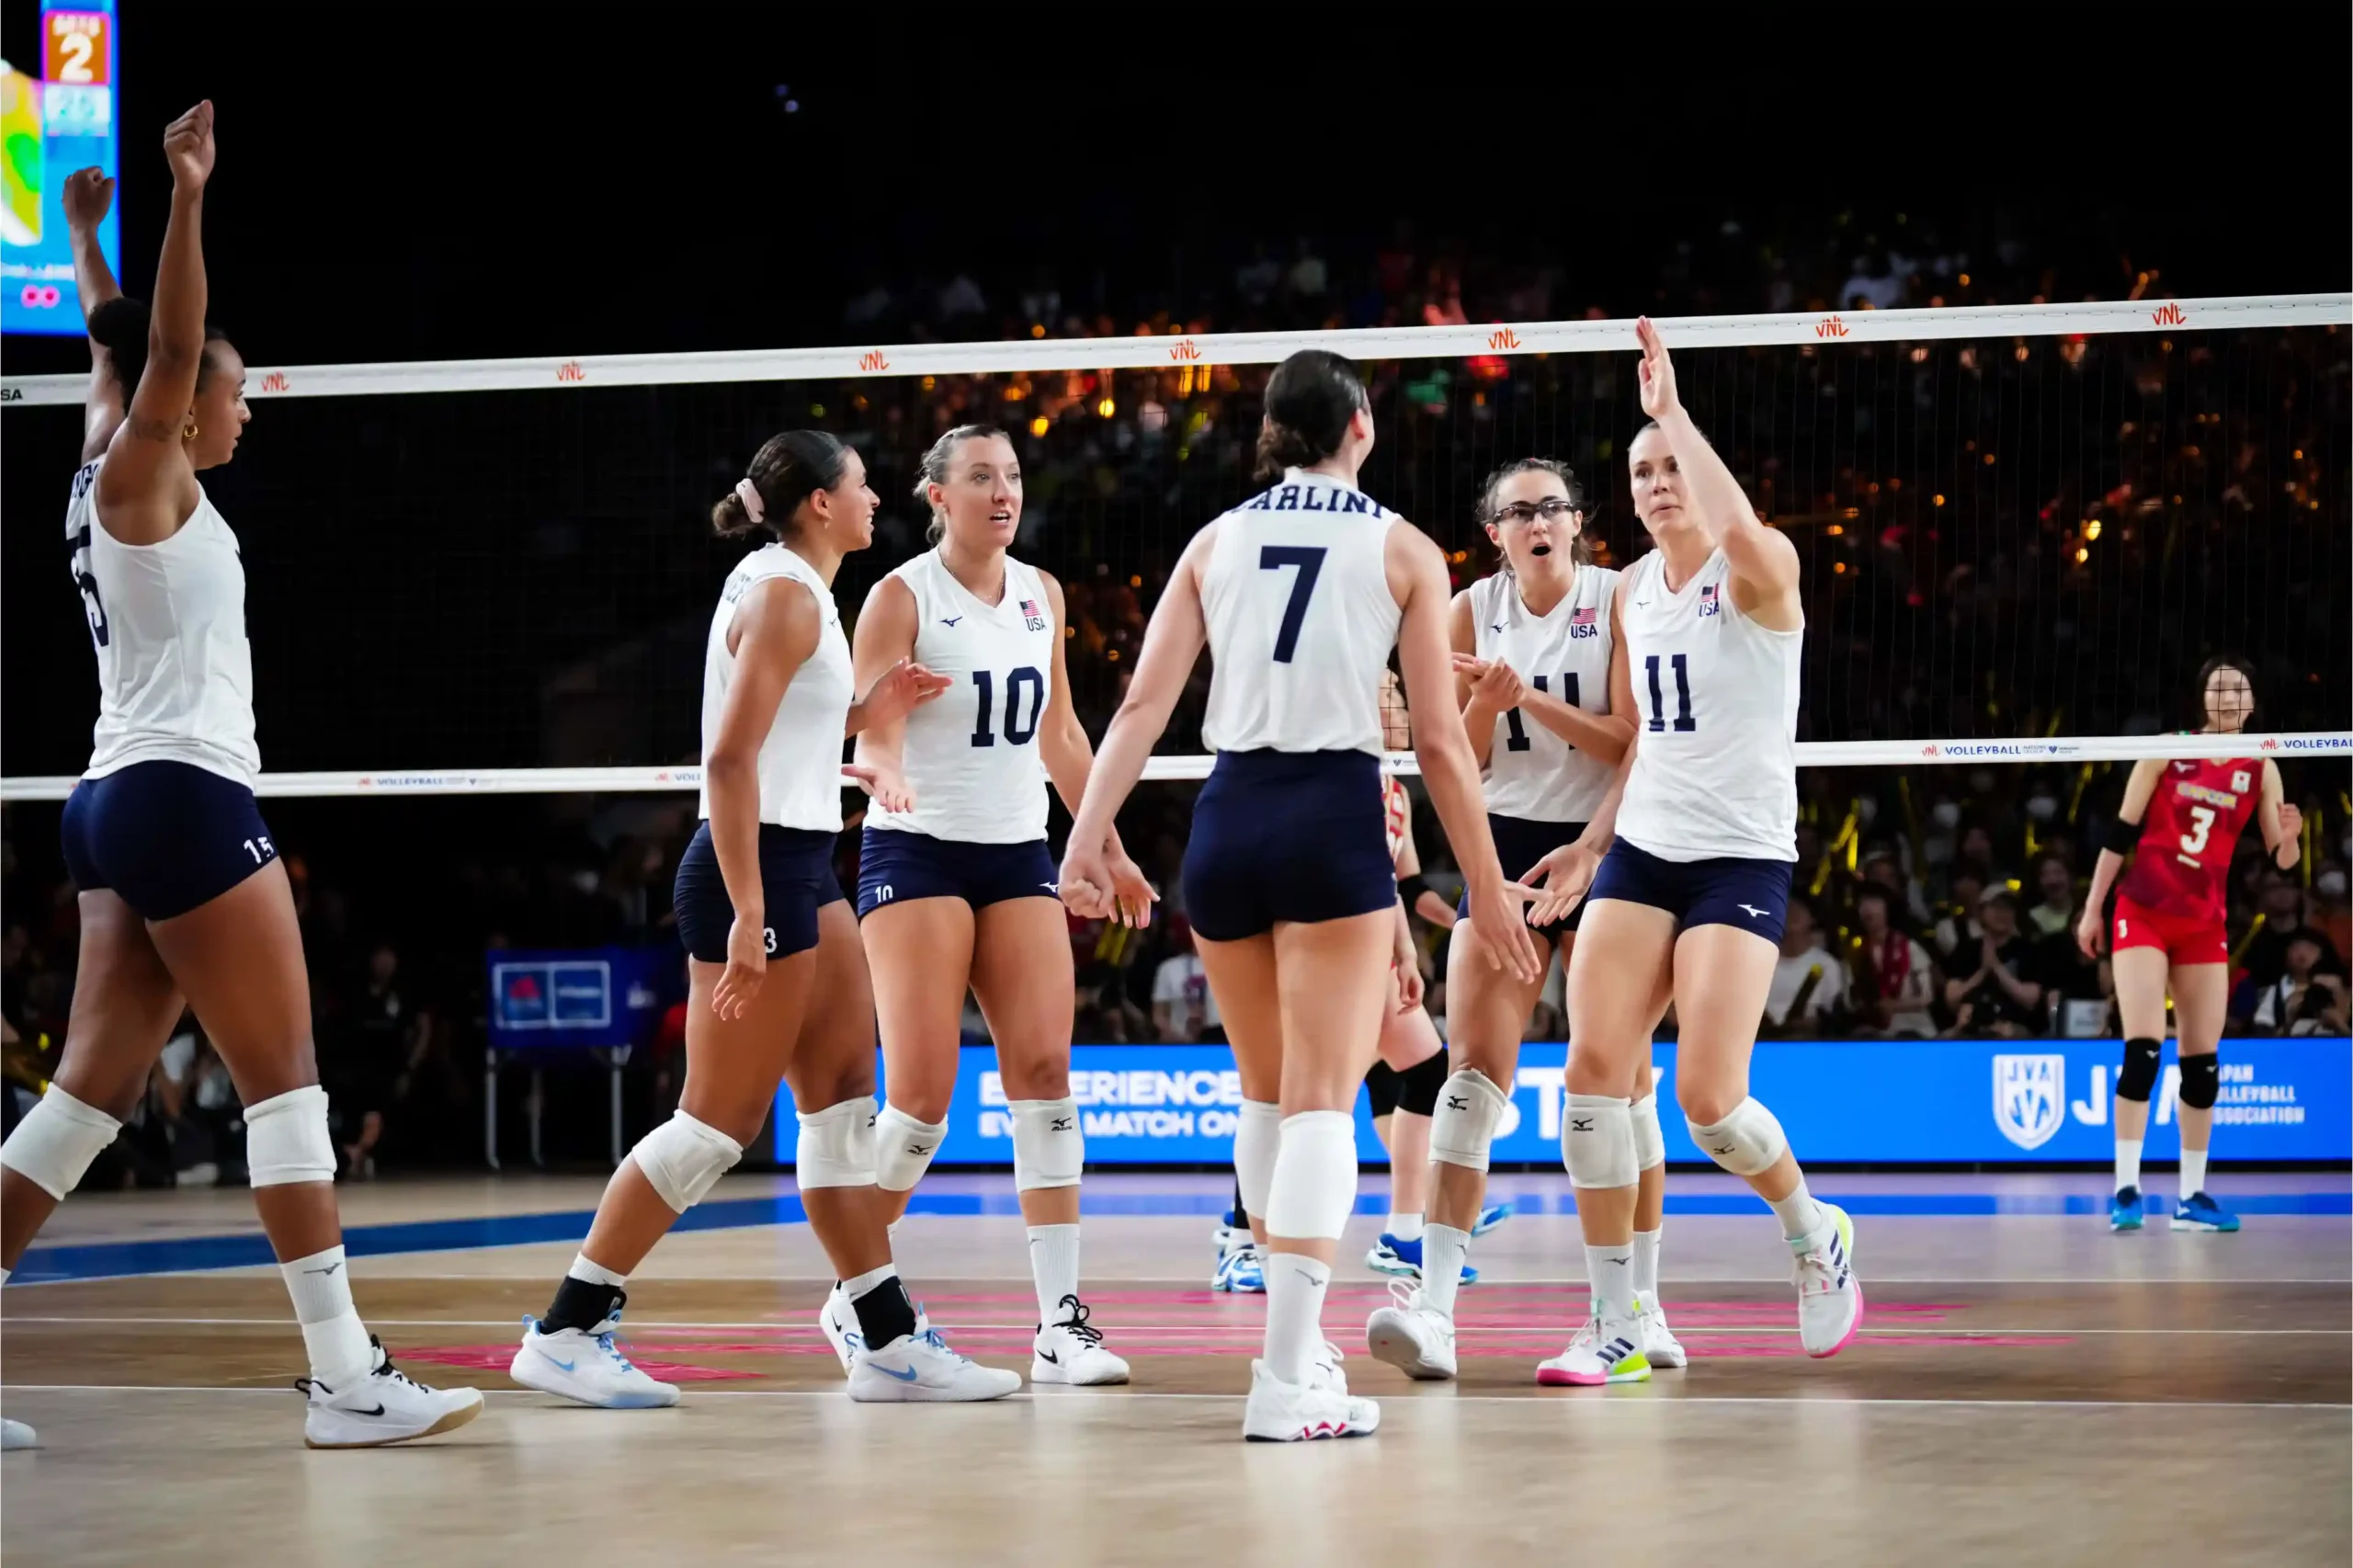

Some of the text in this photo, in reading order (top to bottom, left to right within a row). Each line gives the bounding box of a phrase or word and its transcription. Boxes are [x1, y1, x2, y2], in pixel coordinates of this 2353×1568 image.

[60, 32, 93, 84] 2
[2153, 302, 2187, 325] VNL
[1815, 315, 1849, 337] VNL
[1488, 327, 1520, 350] VNL
[859, 350, 890, 371] VNL
[1170, 339, 1201, 361] VNL
[261, 371, 290, 392] VNL
[556, 360, 586, 382] VNL
[1259, 545, 1328, 664] 7
[1699, 601, 1719, 618] USA
[1026, 618, 1047, 632] USA
[1571, 624, 1597, 639] USA
[1645, 653, 1696, 732] 11
[972, 666, 1044, 747] 10
[1922, 744, 1940, 756] VNL
[1945, 745, 2021, 756] VOLLEYBALL
[2260, 738, 2279, 750] VNL
[2180, 805, 2216, 855] 3
[244, 836, 274, 864] 15
[875, 885, 893, 903] 10
[980, 1071, 1241, 1106] EERIENCE
[2216, 1085, 2296, 1104] OLLEYBALL
[1085, 1111, 1193, 1137] MATCH
[2213, 1107, 2305, 1126] SSOCIATION
